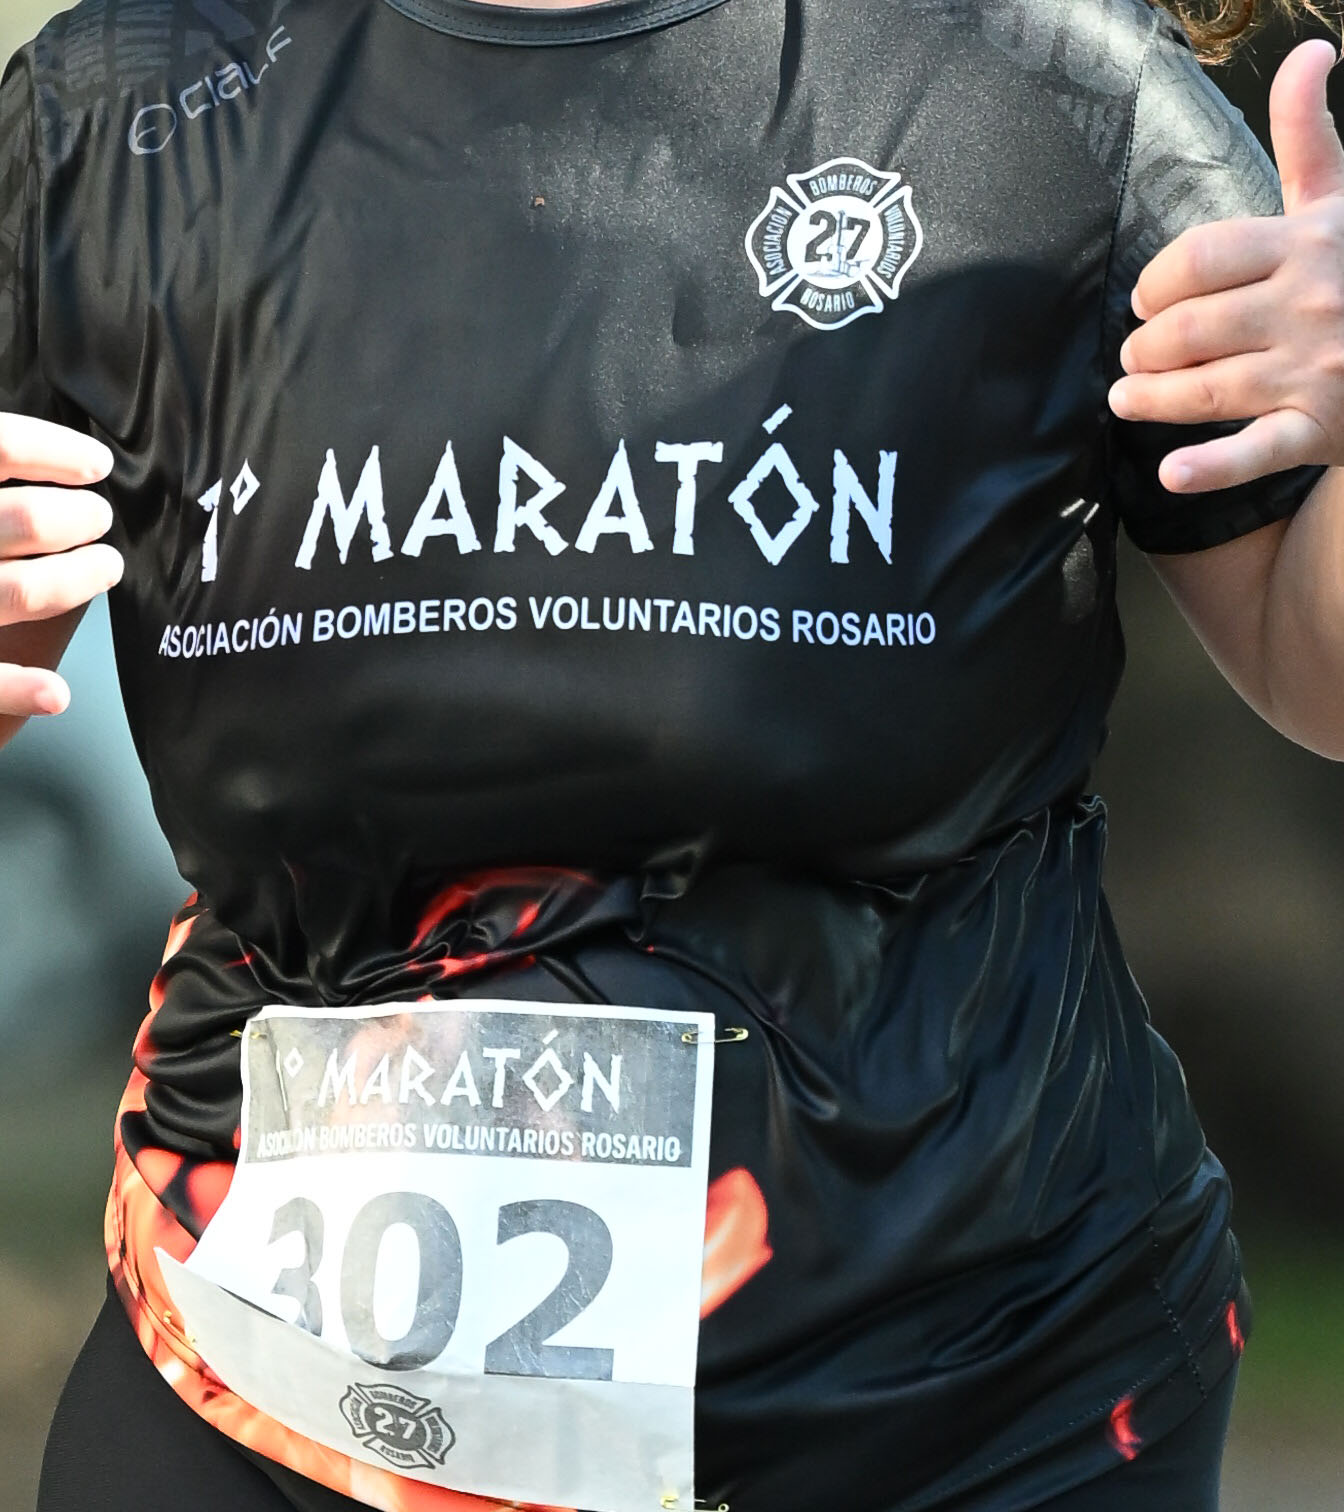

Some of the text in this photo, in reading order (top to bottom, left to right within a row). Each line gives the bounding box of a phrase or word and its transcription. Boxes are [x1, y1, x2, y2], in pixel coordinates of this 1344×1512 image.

[809, 174, 878, 197] BOMBEROS
[804, 209, 871, 263] 27
[799, 287, 855, 313] ROSARIO
[295, 403, 898, 570] MARATÓN
[158, 595, 936, 659] ASOCIACIÓN BOMBEROS VOLUNTARIOS ROSARIO
[317, 1029, 623, 1114] MARATÓN
[319, 1121, 417, 1151] BOMBEROS
[423, 1121, 574, 1156] VOLUNTARIOS
[581, 1131, 681, 1163] ROSARIO
[267, 1191, 615, 1381] 302
[374, 1406, 417, 1440] 27
